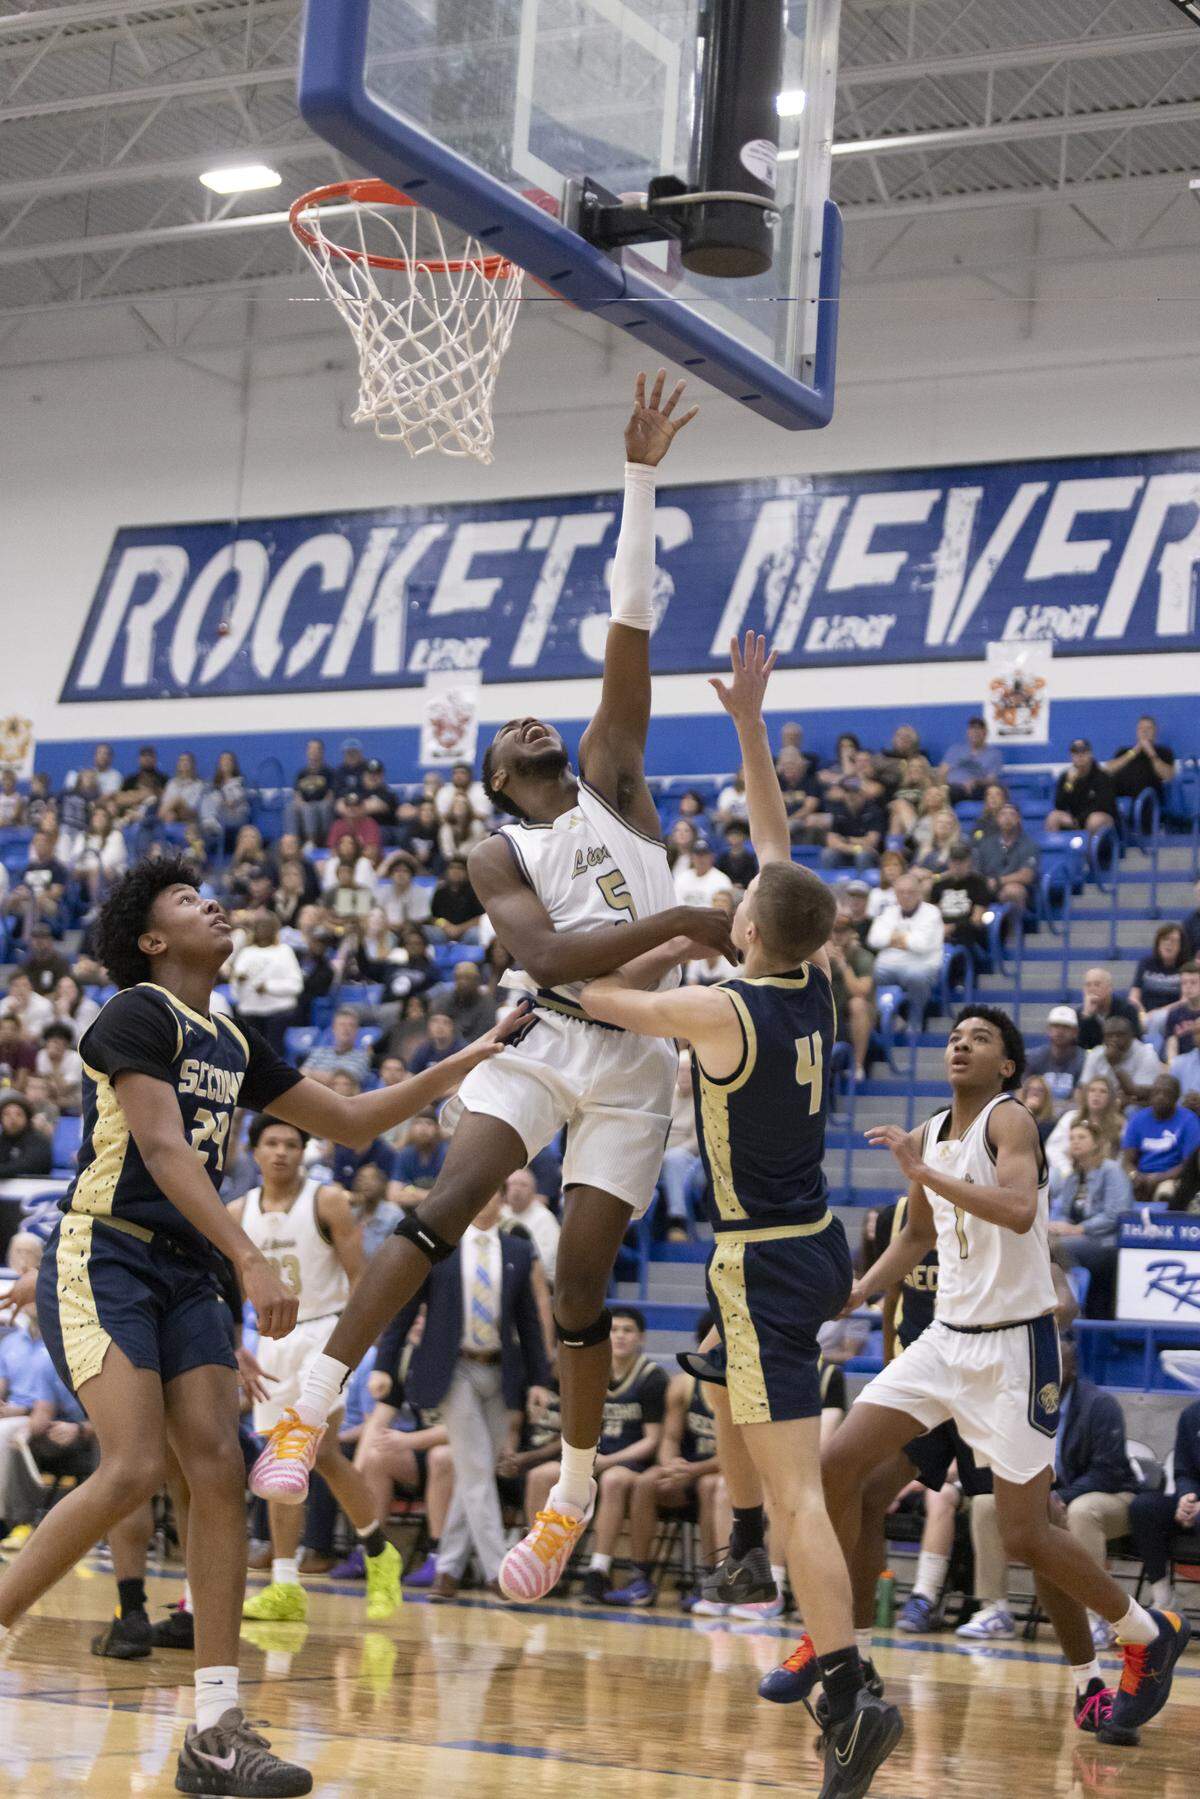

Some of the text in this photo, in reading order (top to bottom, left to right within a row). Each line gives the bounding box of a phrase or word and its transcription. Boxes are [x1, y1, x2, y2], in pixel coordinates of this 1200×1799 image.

[709, 472, 1200, 657] NEVER
[596, 868, 638, 926] 5
[178, 1059, 245, 1106] SECON
[795, 1031, 823, 1115] 4
[1180, 1226, 1200, 1241] YO
